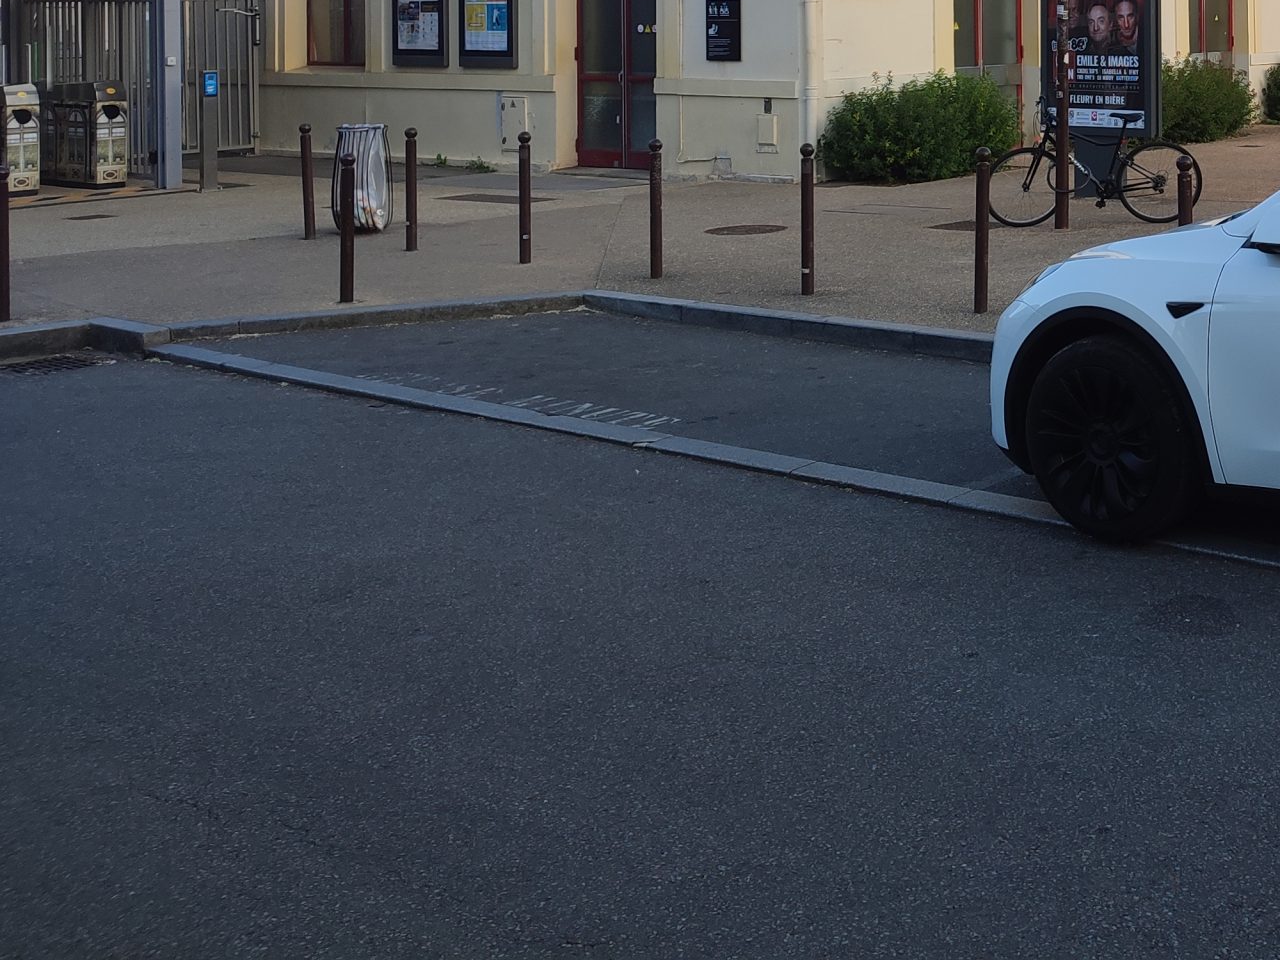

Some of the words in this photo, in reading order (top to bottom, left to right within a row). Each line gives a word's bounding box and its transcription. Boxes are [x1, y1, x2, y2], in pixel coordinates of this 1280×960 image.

[1076, 54, 1099, 67] EMILE
[1099, 55, 1107, 67] &
[1107, 55, 1139, 68] IMAGES
[1069, 94, 1094, 104] FLEURY
[1095, 95, 1104, 104] EN
